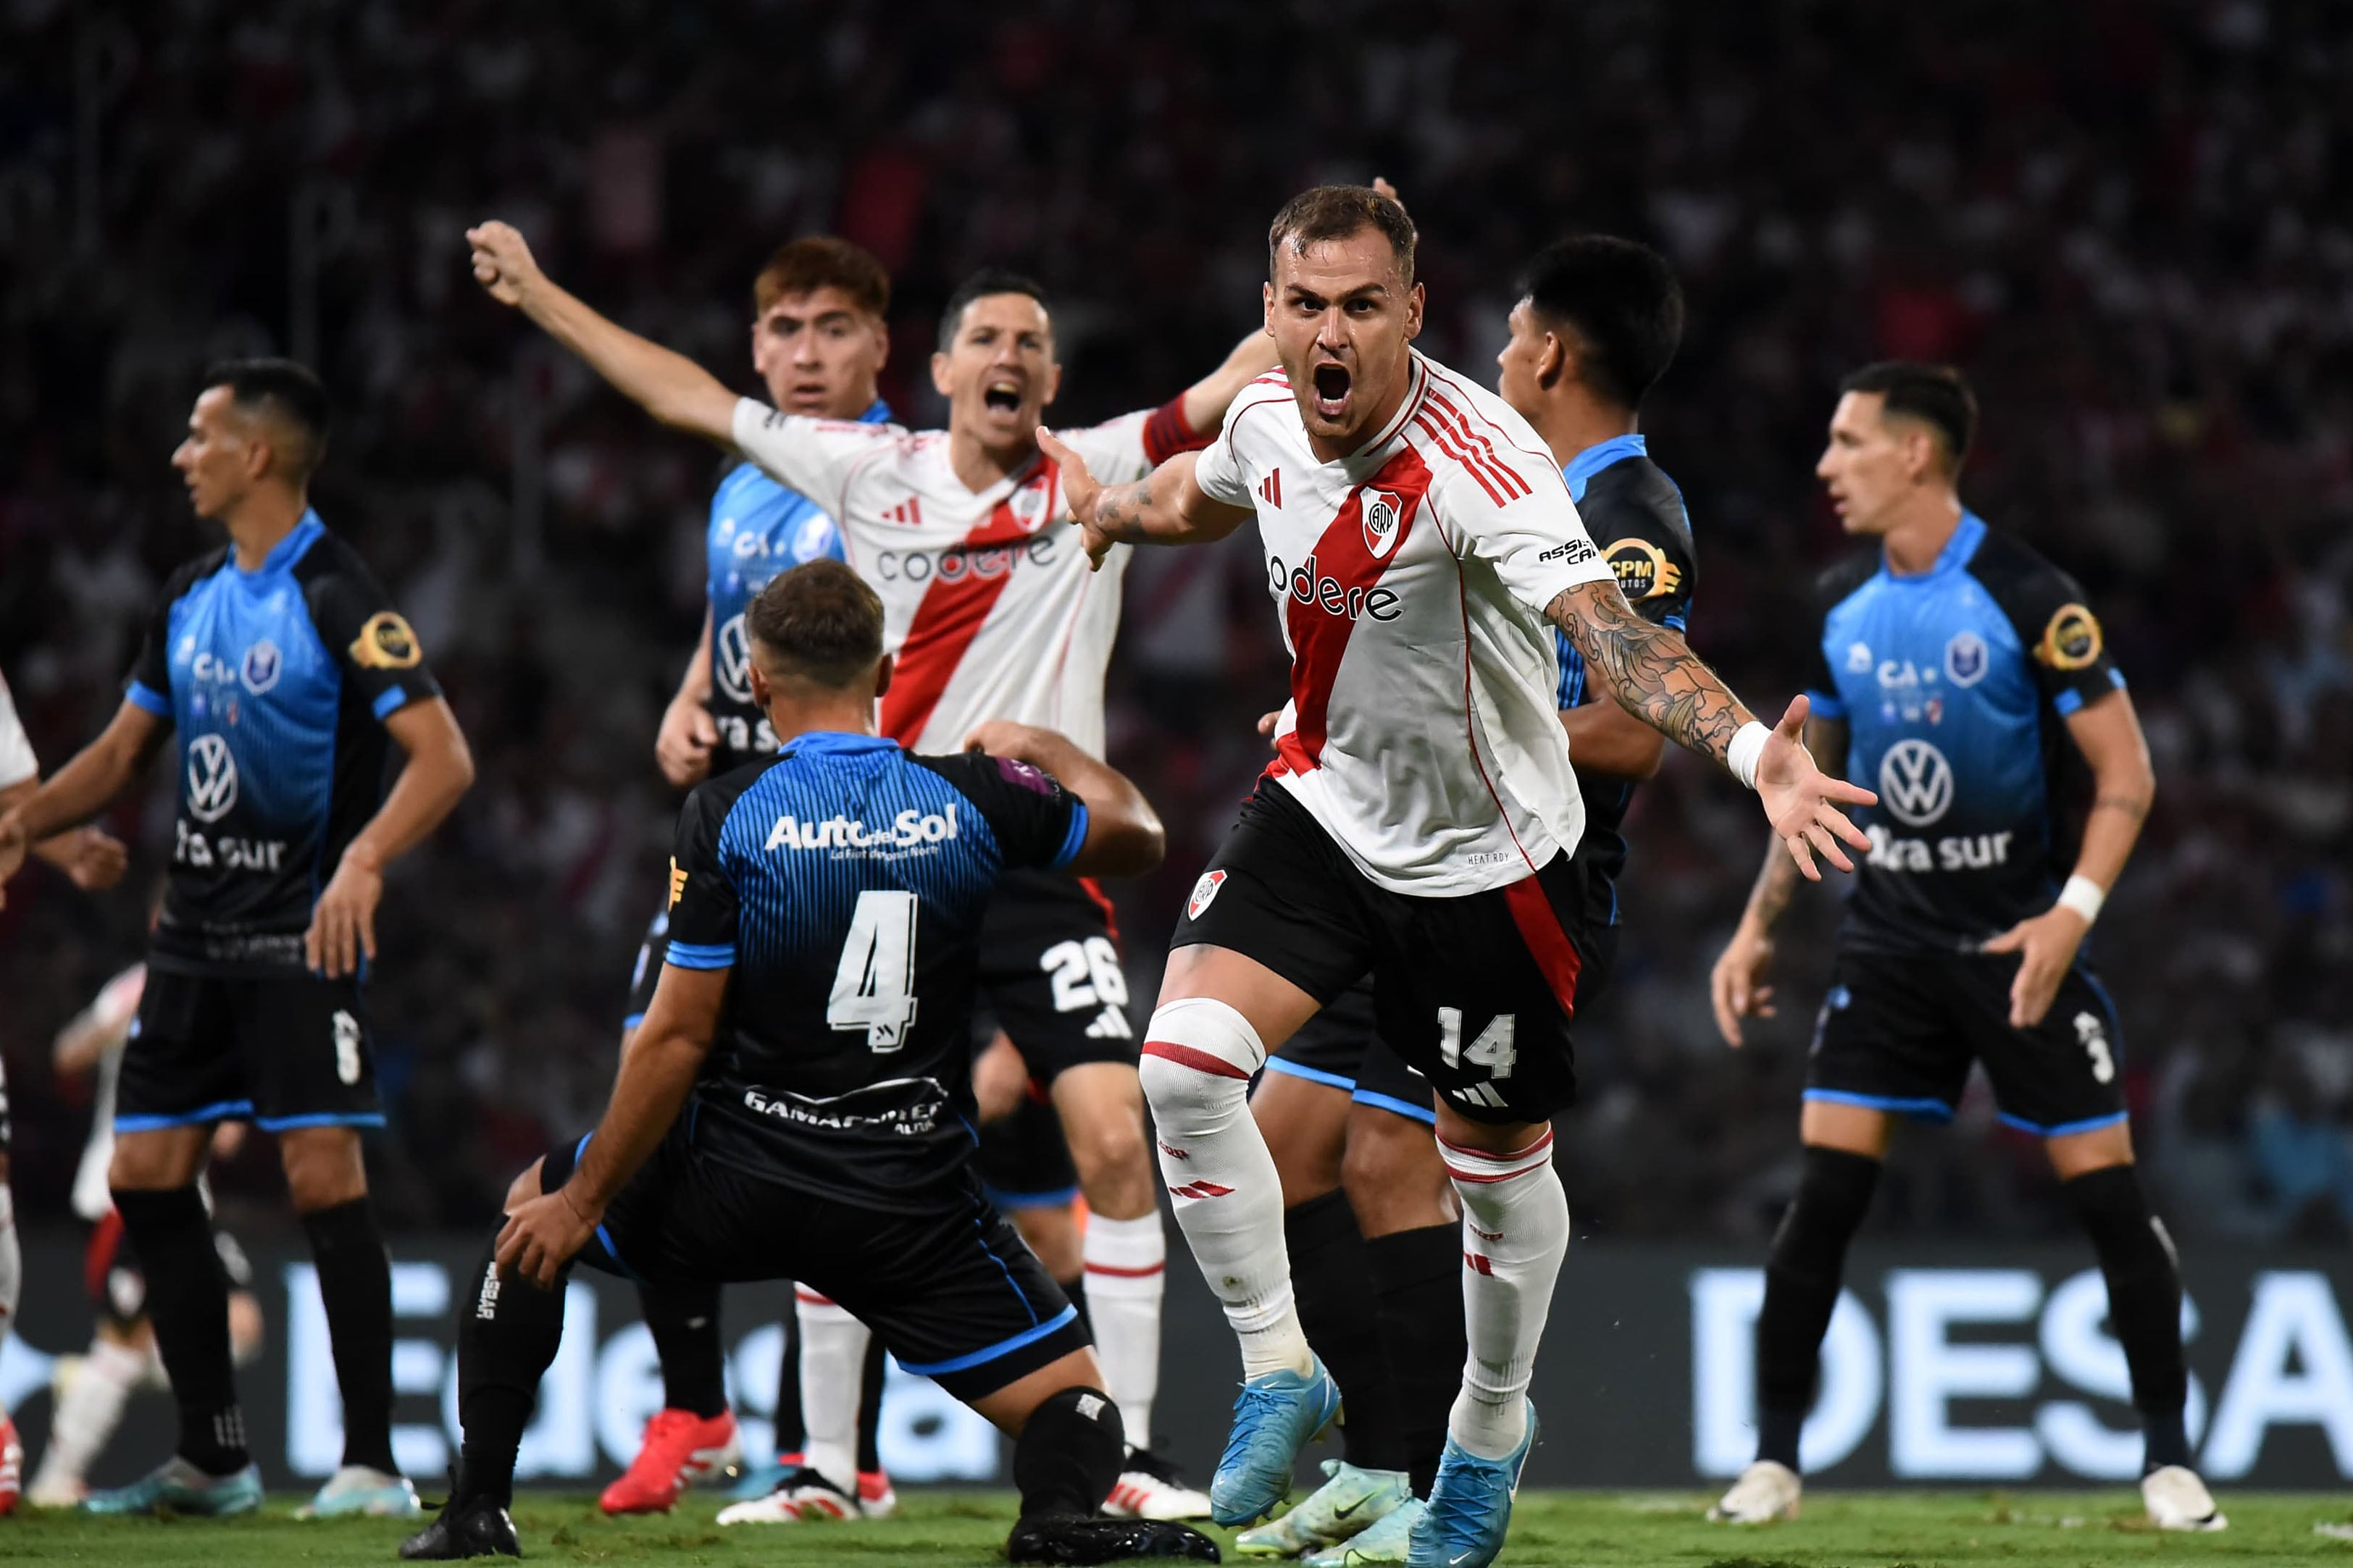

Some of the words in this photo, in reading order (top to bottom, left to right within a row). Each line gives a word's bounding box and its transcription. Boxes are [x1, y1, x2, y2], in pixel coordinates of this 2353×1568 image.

[1937, 831, 2014, 869] sur
[827, 890, 919, 1053] 4
[1040, 936, 1129, 1013] 26
[1437, 1007, 1517, 1079] 14
